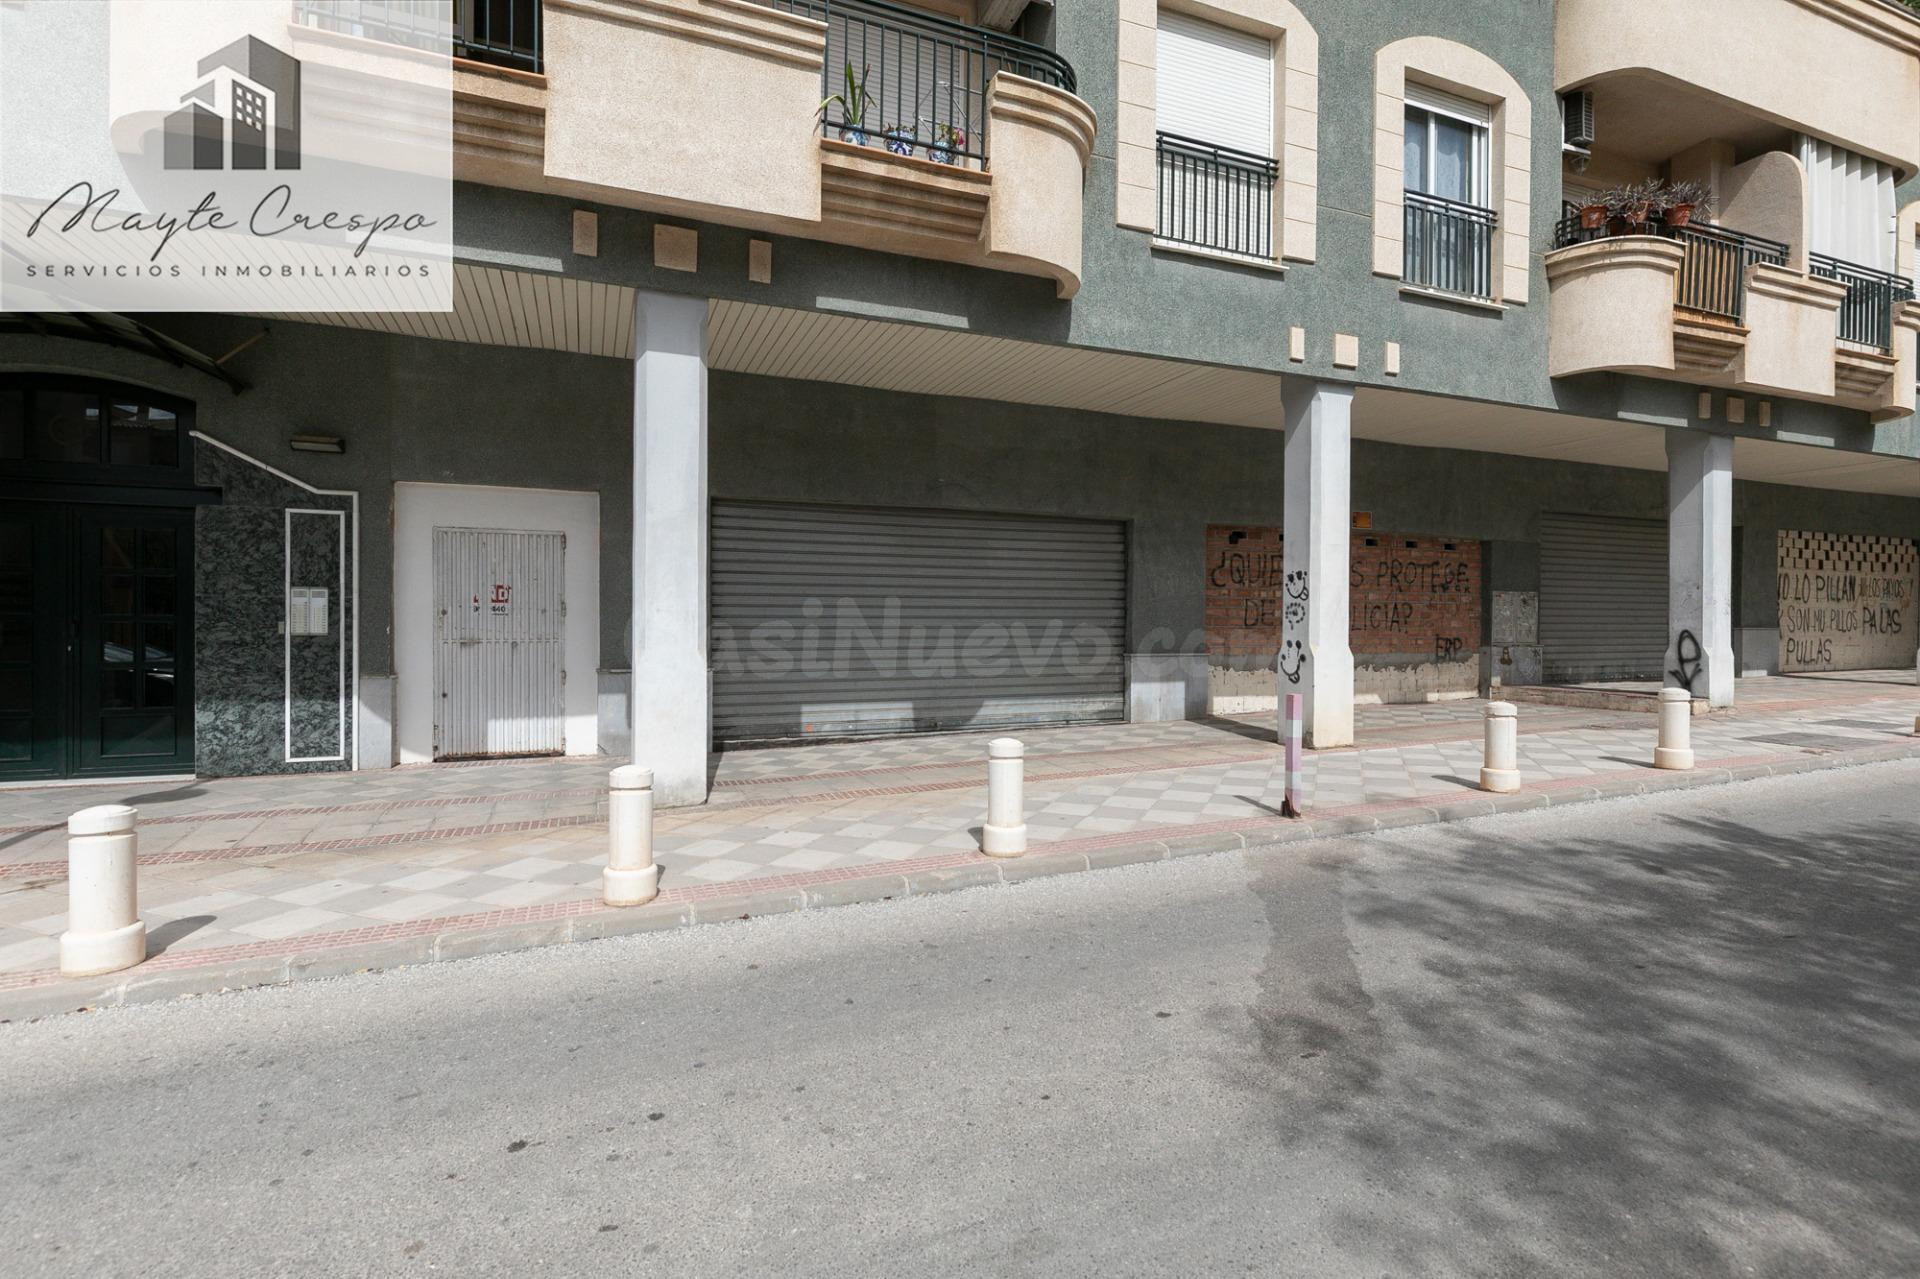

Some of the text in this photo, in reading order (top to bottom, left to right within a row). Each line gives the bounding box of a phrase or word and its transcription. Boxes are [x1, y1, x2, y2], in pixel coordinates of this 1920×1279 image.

[1376, 559, 1470, 593] PROTEGE
[1815, 574, 1856, 603] PILLAN
[1786, 605, 1810, 633] SON
[1785, 636, 1832, 665] PULLAS
